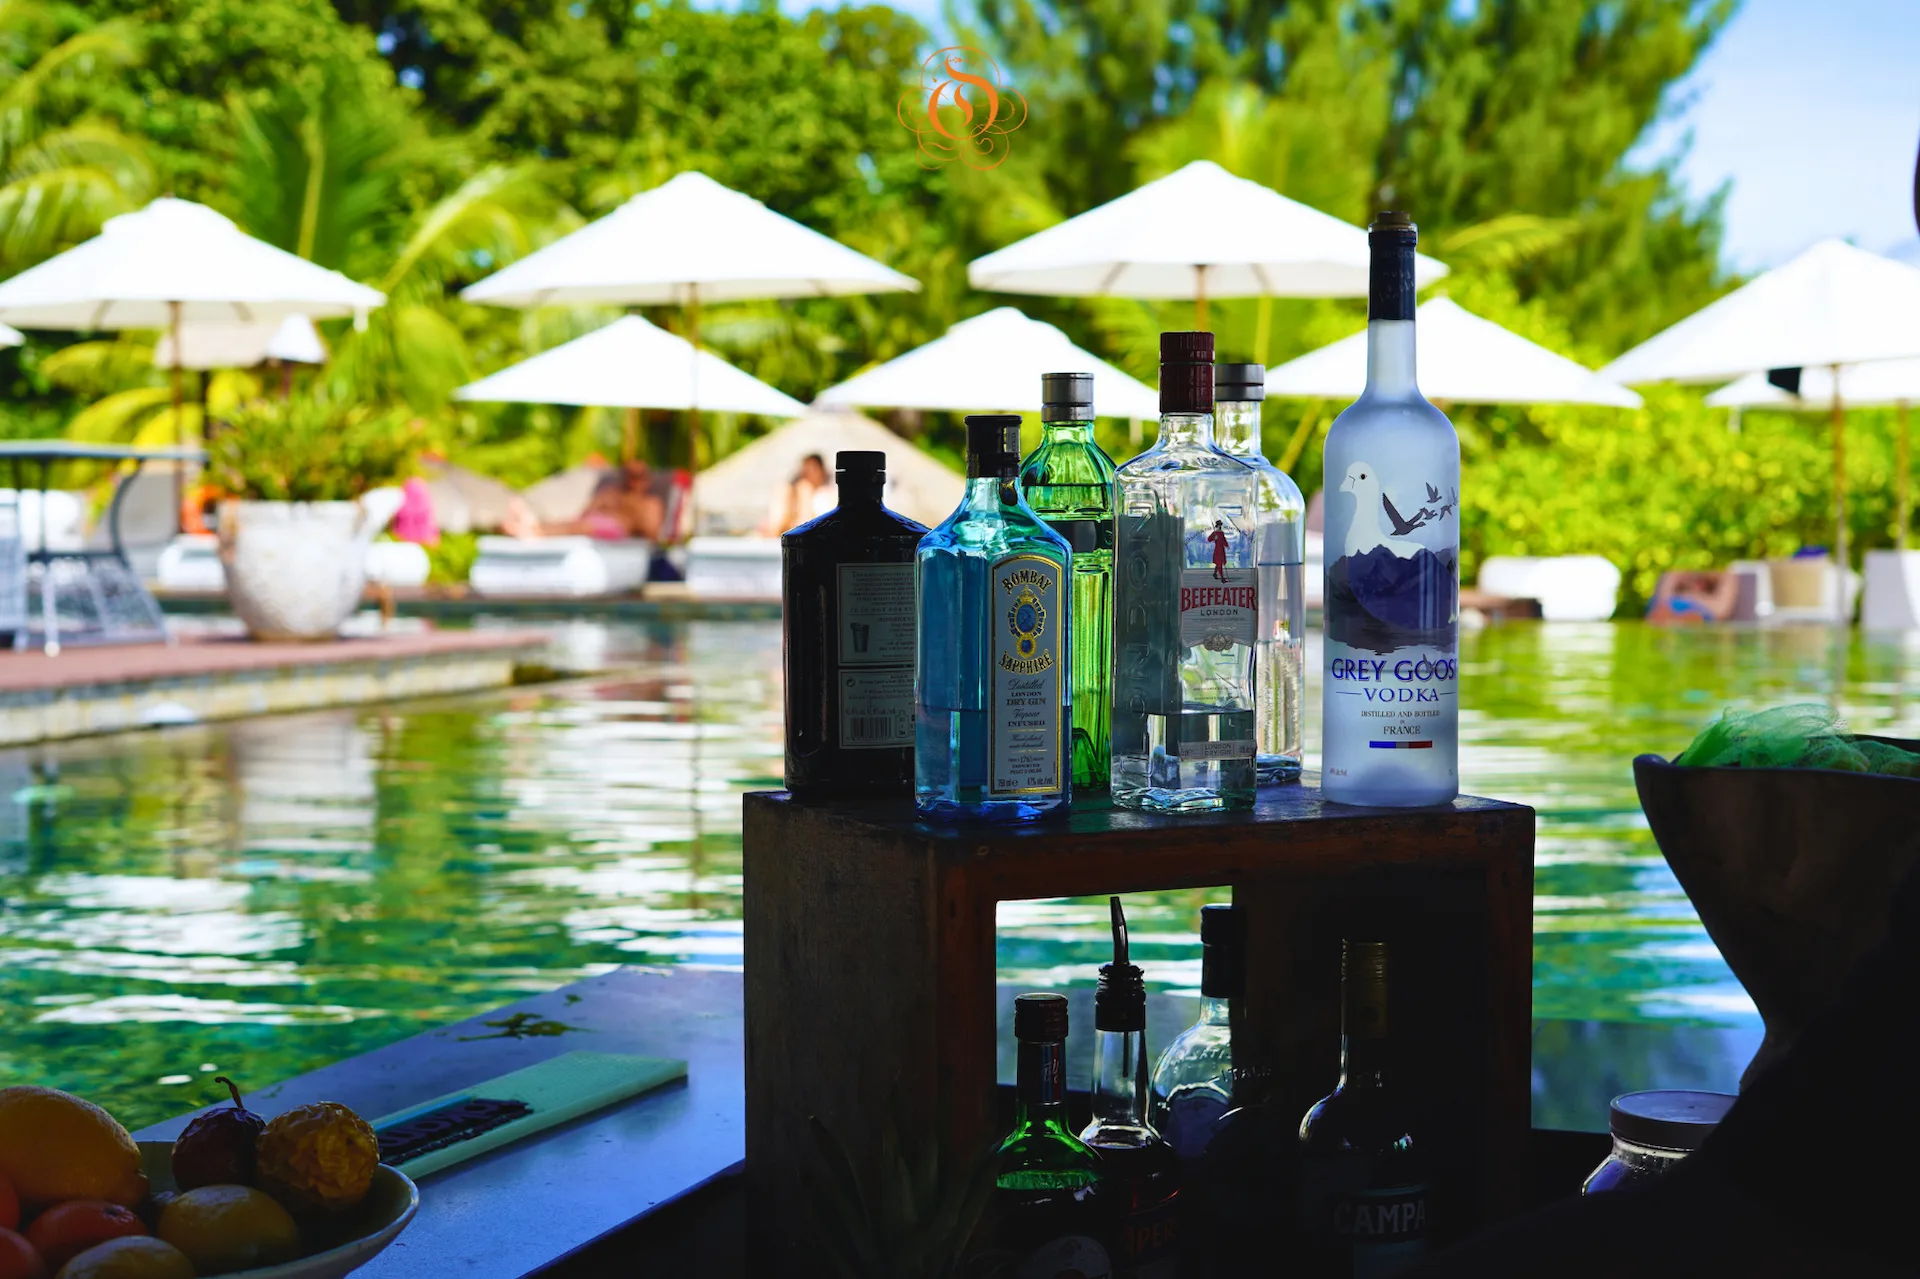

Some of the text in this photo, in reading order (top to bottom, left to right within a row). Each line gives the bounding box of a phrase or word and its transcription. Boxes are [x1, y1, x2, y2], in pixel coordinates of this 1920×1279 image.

[1002, 569, 1053, 595] BOMBAY
[1181, 586, 1257, 612] BEEFEATER
[1200, 608, 1239, 617] LONDON
[998, 649, 1054, 676] SAPPHIRE
[1331, 658, 1387, 682] GREY
[1006, 697, 1047, 706] DRY GIN
[1363, 687, 1440, 703] VODKA
[1361, 709, 1441, 718] DISTILLED AND BOTTLED
[1383, 725, 1421, 735] FRANCE
[1334, 1197, 1427, 1235] CAMPA
